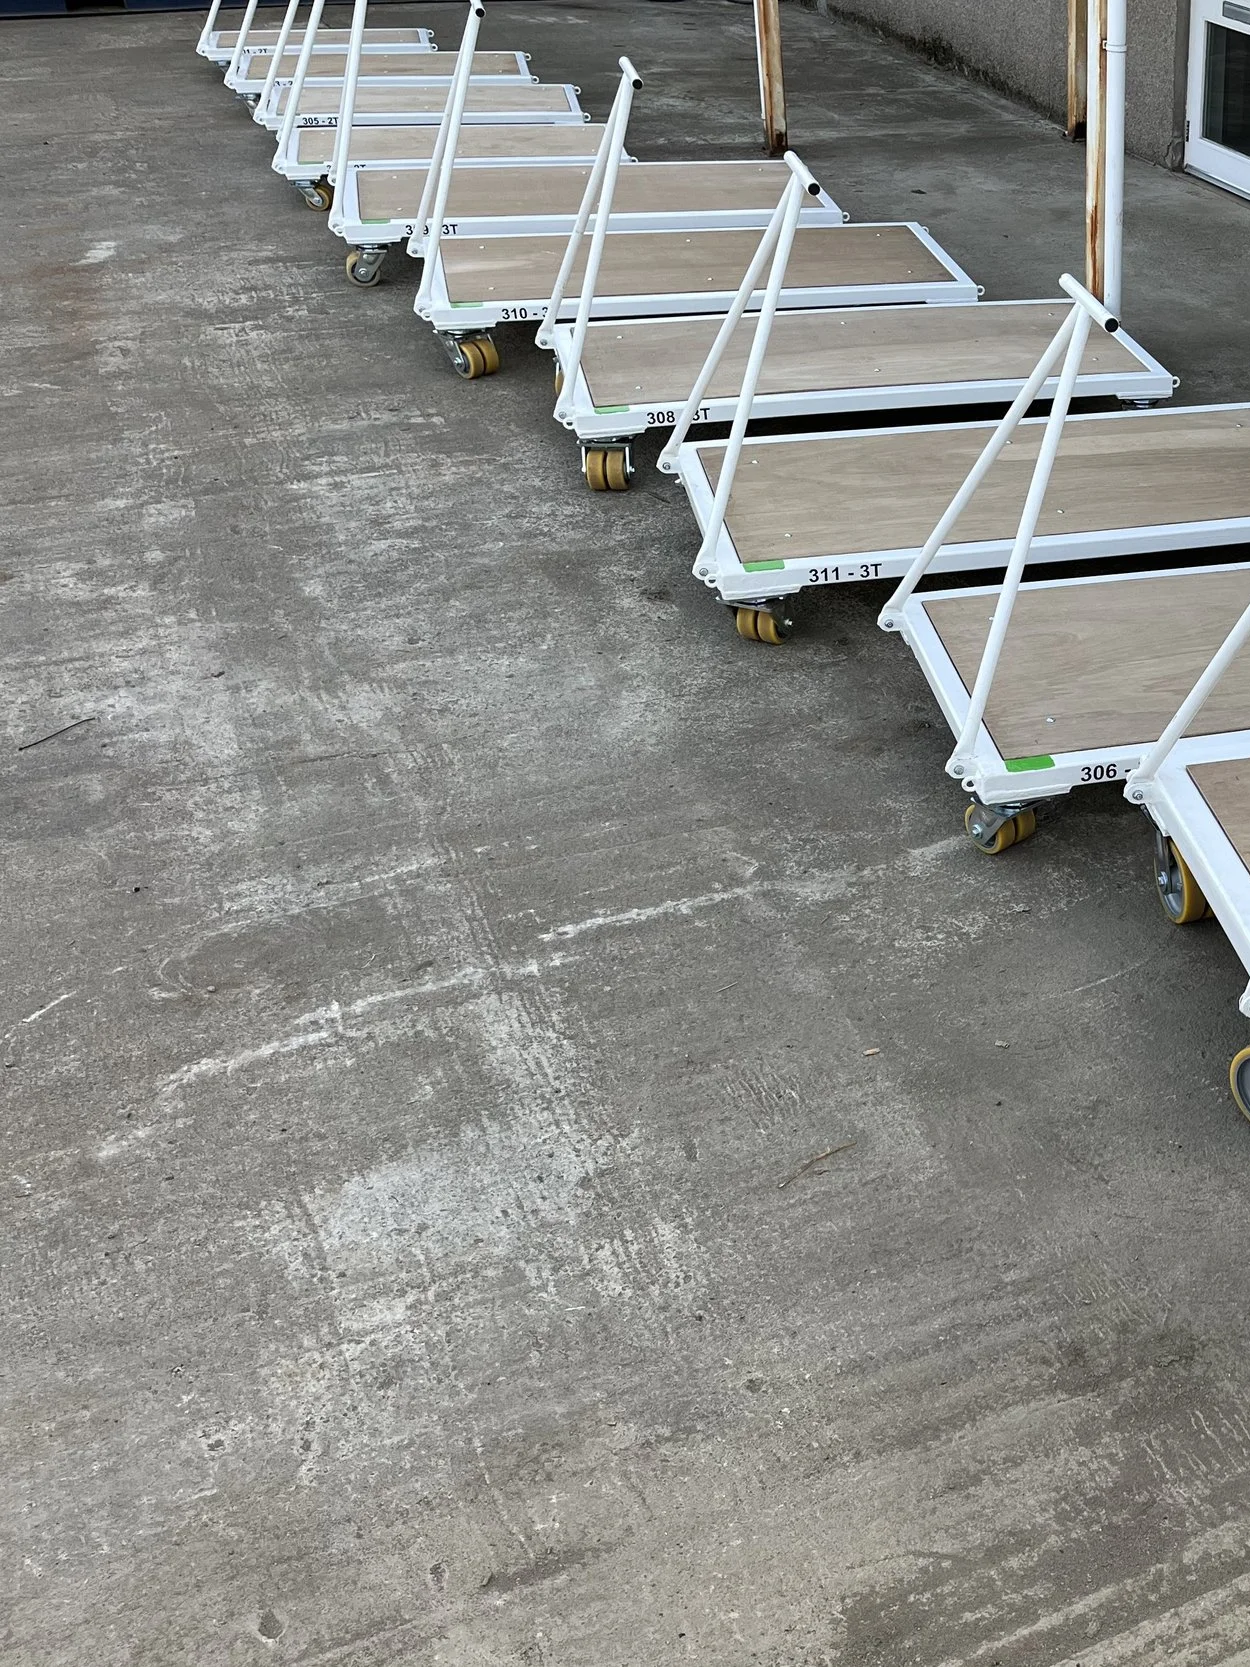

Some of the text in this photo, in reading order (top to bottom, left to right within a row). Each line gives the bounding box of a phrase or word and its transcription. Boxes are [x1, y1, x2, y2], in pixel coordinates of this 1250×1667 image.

[302, 117, 319, 125] 305
[405, 224, 458, 236] 39 3T
[501, 307, 528, 320] 310
[647, 410, 676, 425] 308
[808, 567, 840, 583] 311
[860, 563, 882, 579] 3T
[1080, 763, 1118, 782] 306
